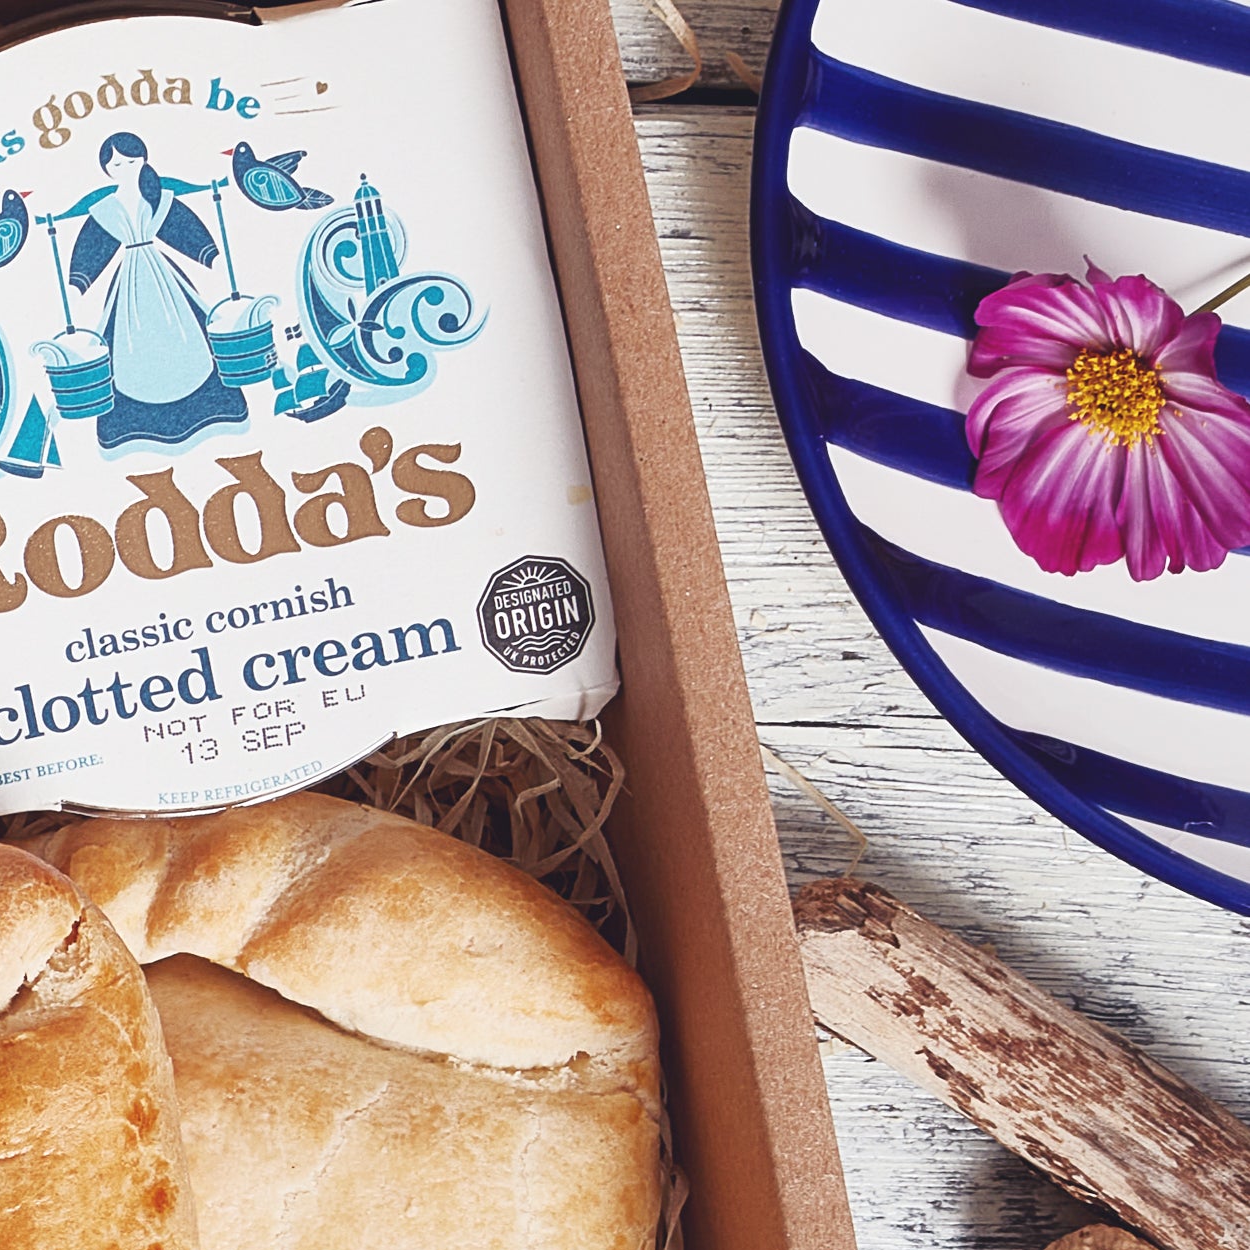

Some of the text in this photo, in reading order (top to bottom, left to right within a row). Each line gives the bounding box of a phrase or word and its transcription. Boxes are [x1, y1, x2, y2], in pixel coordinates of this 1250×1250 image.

[32, 69, 192, 150] godda
[205, 77, 261, 119] be
[494, 581, 572, 610] DESIGNATED
[494, 595, 580, 639] ORIGIN
[65, 577, 355, 663] classic cornish
[243, 615, 462, 691] cream
[503, 631, 580, 666] UK PROTECTED
[144, 684, 366, 742] NOT FOR EU
[181, 721, 305, 764] 13 SEP
[36, 754, 104, 779] BEFORE:
[158, 760, 323, 805] KEEP REFRIGERATED
